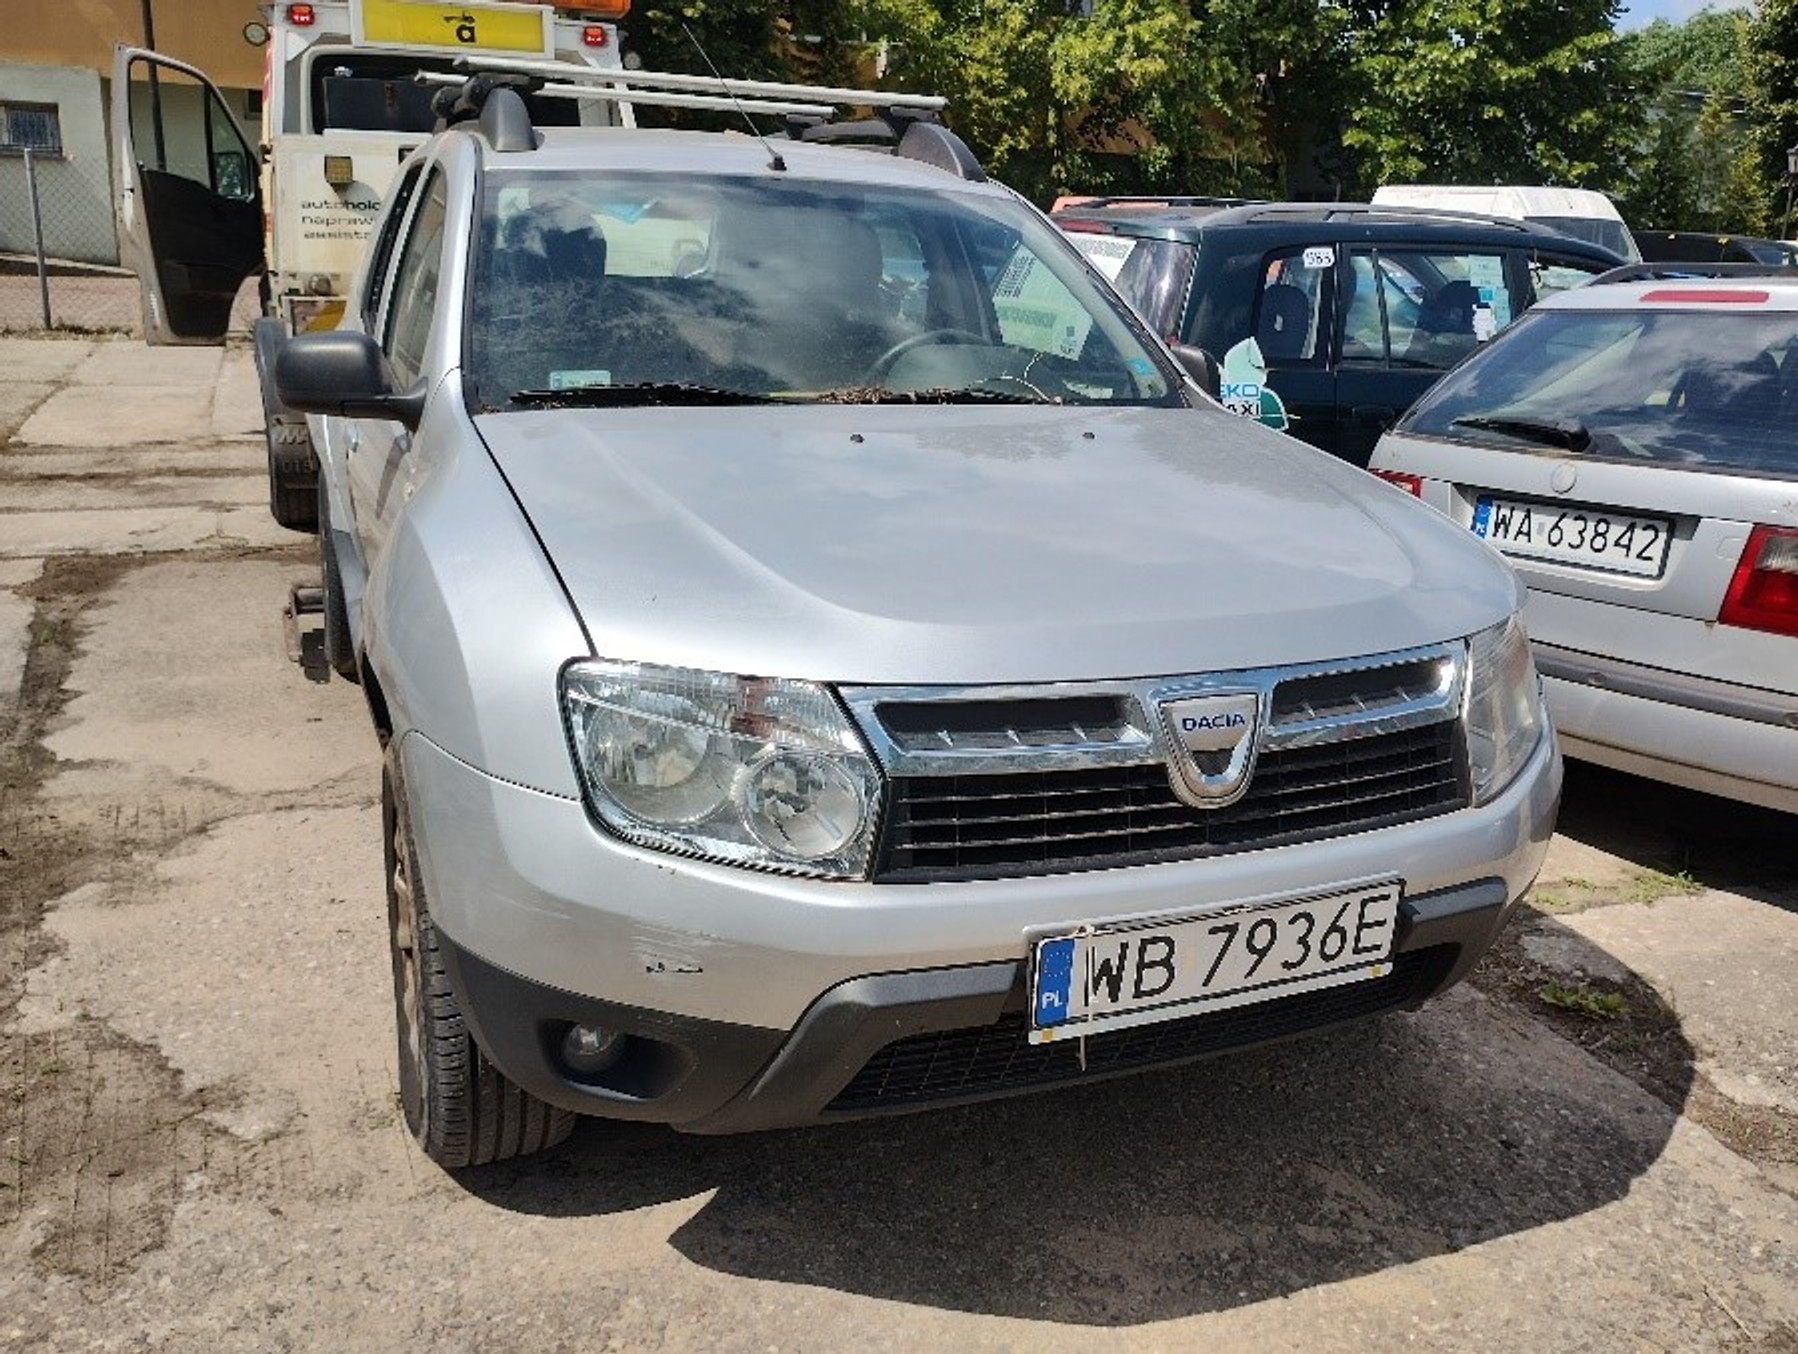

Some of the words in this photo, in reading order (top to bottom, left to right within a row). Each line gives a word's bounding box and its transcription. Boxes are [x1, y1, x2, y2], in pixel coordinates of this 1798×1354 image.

[1492, 504, 1532, 543] WA
[1548, 511, 1659, 561] 63842
[1182, 713, 1245, 731] DACIA
[1084, 935, 1176, 1007] WB
[1201, 893, 1392, 987] 7936E
[1042, 990, 1063, 1009] PL
